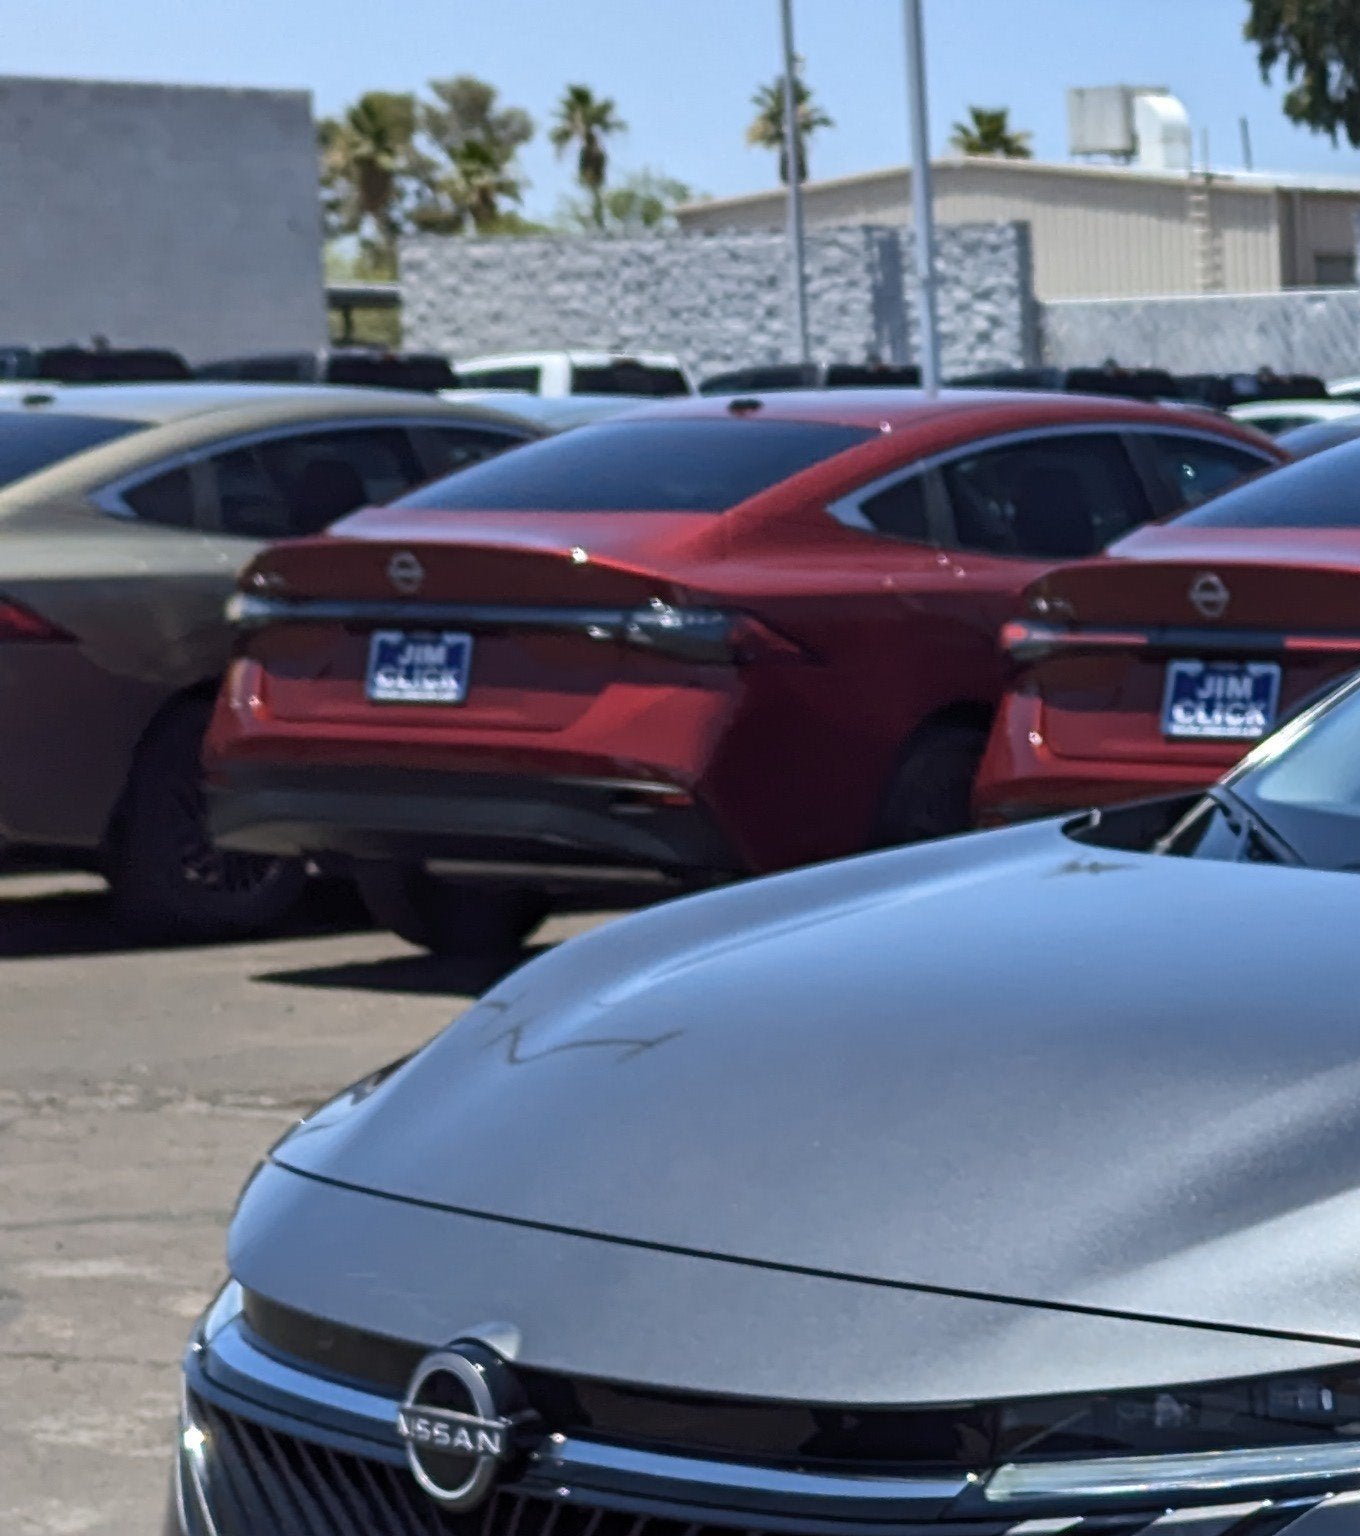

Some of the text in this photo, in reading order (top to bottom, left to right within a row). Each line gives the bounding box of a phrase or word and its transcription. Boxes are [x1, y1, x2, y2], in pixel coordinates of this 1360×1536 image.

[398, 644, 446, 664] JIM
[377, 667, 459, 690] CLICK
[1196, 676, 1253, 699] JIM
[1172, 701, 1265, 725] CLICK
[397, 1411, 501, 1455] NISSAN
